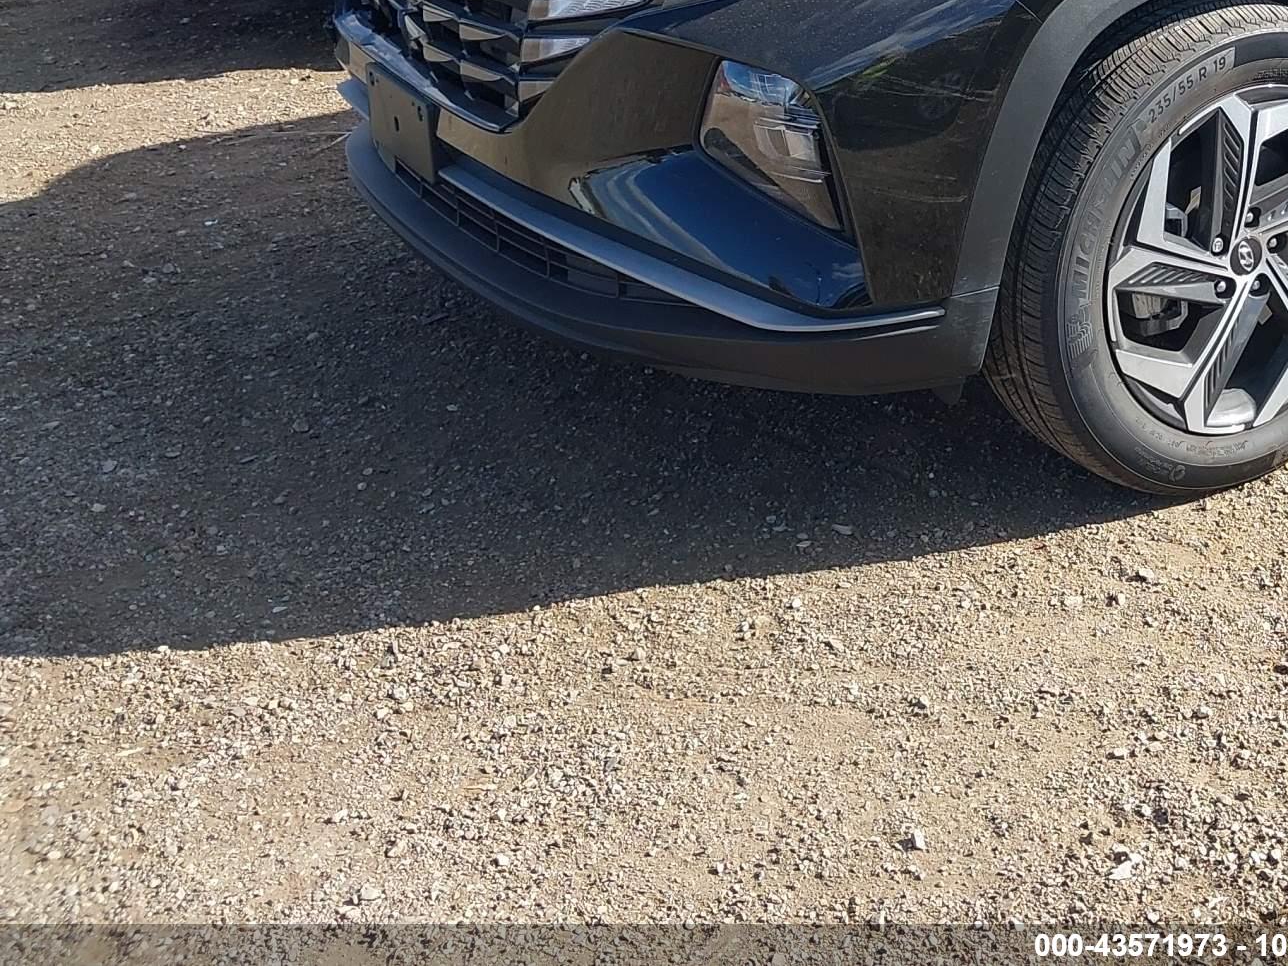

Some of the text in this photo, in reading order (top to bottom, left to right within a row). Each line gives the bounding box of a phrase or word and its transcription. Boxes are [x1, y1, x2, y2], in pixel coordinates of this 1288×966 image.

[1148, 56, 1226, 123] 235/55 R 19
